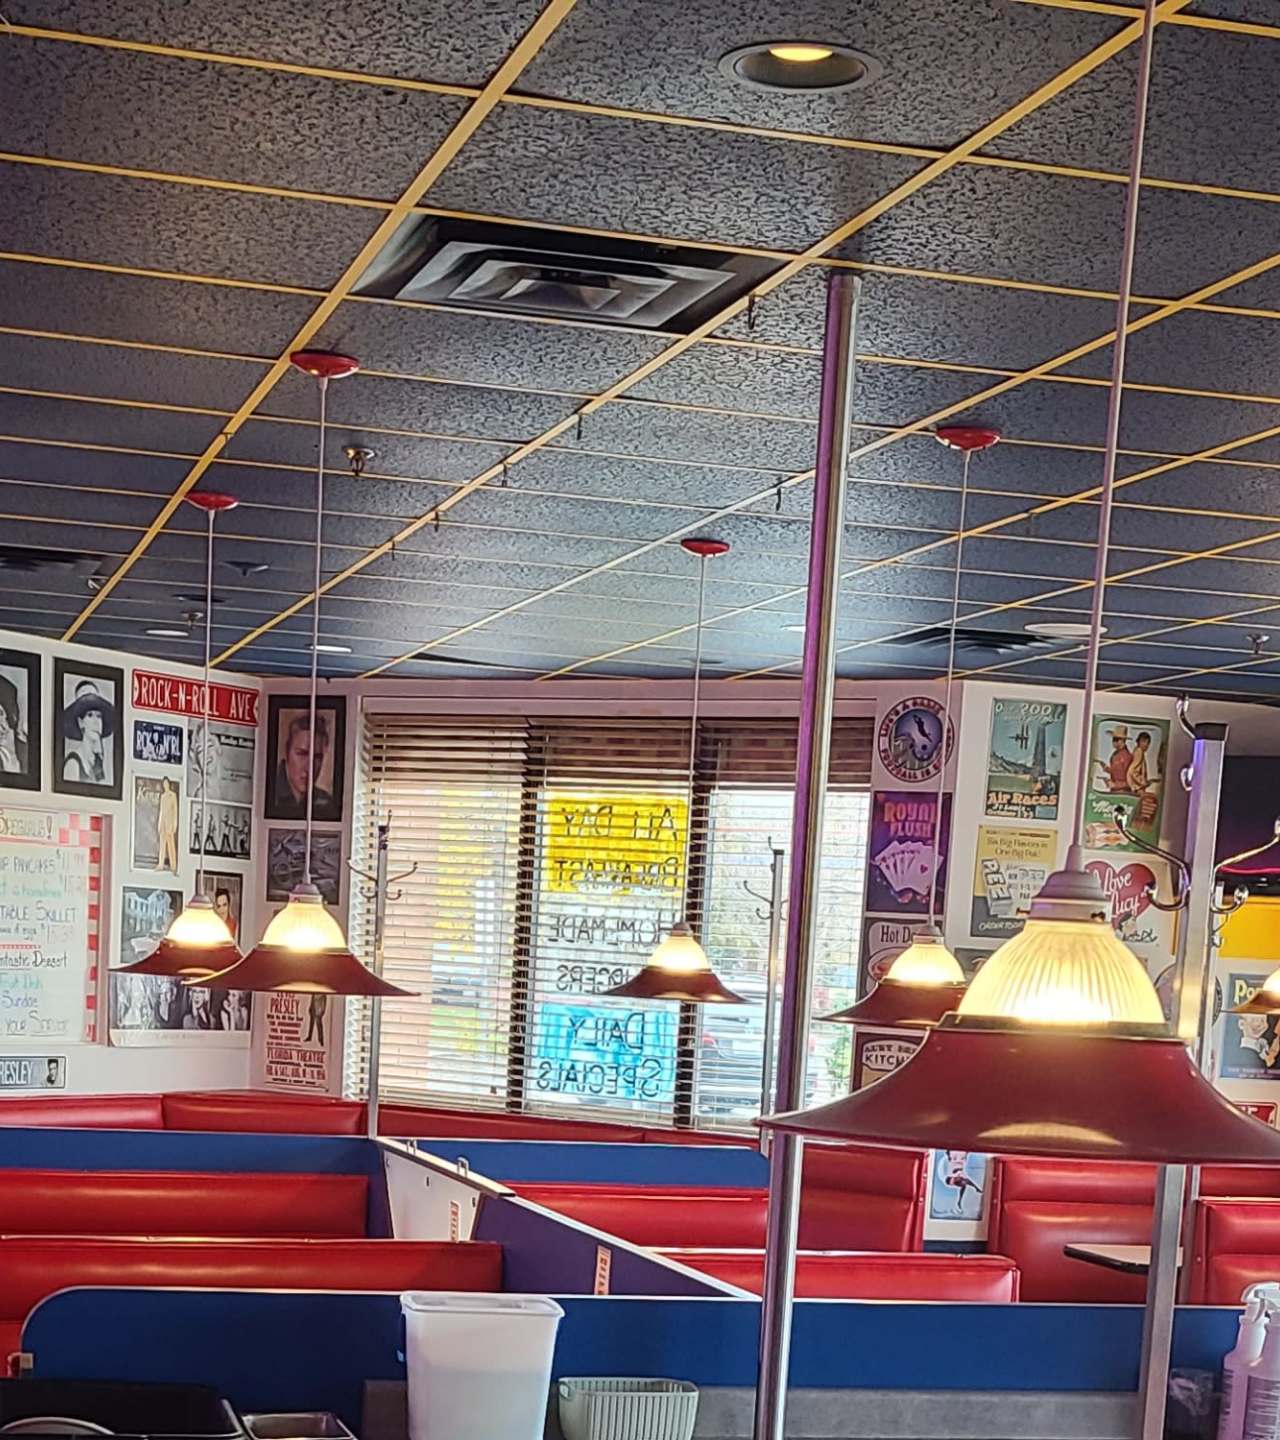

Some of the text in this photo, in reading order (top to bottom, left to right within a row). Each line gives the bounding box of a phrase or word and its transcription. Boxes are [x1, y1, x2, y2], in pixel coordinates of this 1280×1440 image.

[141, 676, 252, 720] ROCK-N-ROLL AVE
[889, 820, 933, 839] FLUSH
[1104, 867, 1132, 895] Love
[36, 900, 76, 923] SKILLET
[1111, 890, 1141, 918] Lucy
[880, 924, 900, 943] Hot
[269, 997, 301, 1016] PRESLEY
